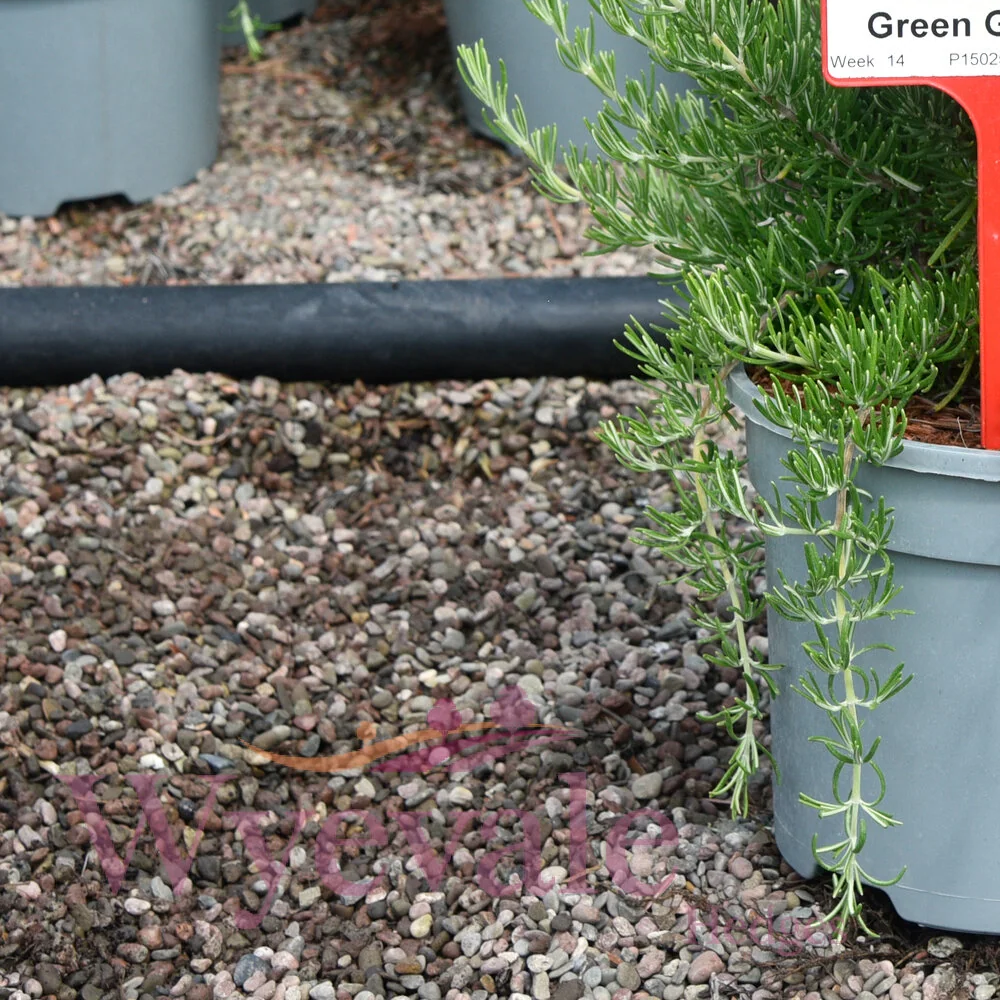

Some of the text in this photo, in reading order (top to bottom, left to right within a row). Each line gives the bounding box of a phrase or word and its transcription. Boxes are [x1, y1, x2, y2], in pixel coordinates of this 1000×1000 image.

[867, 11, 971, 39] Green
[830, 55, 905, 68] Week 14
